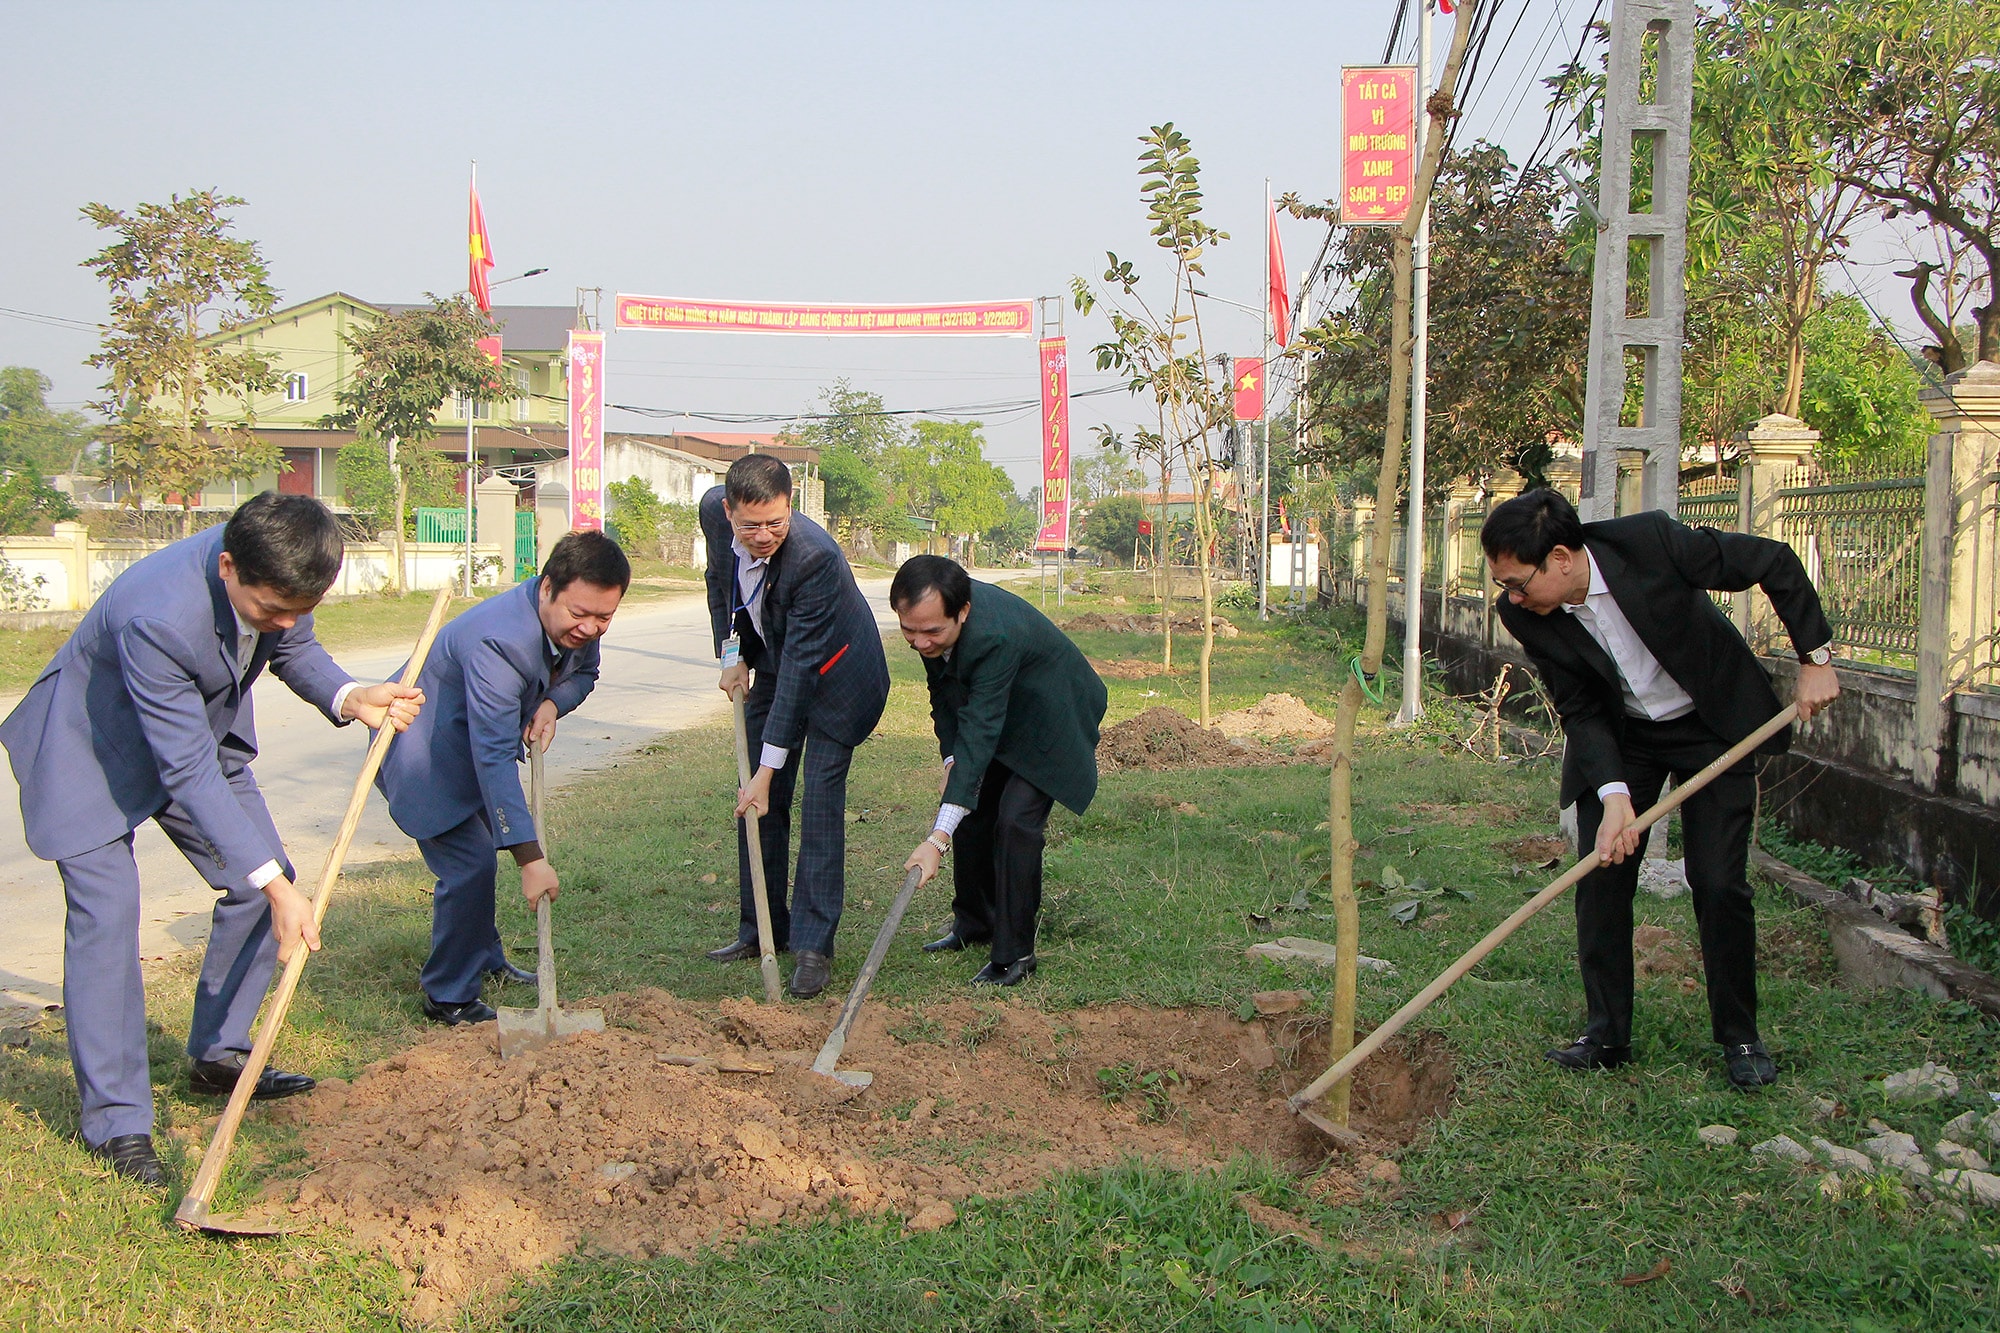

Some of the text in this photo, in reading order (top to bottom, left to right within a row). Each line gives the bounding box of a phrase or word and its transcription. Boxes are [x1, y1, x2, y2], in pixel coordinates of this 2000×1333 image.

[1359, 77, 1397, 100] TẤT CẢ
[1372, 106, 1384, 125] VÌ
[1350, 131, 1406, 151] MÔI TRƯỜNG
[1363, 160, 1393, 177] XANH
[1349, 186, 1377, 206] SẠCH
[1386, 185, 1406, 205] ĐẸP
[626, 304, 647, 323] NHIỆT
[648, 304, 663, 324] LIỆT
[664, 306, 684, 321] CHÀO
[708, 309, 718, 323] 90
[719, 308, 736, 323] NĂM
[738, 309, 758, 324] NGÀY
[759, 309, 782, 325] THÀNH
[784, 310, 798, 328] LẬP
[799, 308, 820, 326] ĐẢNG
[821, 311, 842, 330] CỘNG
[843, 309, 859, 326] SẢN
[860, 311, 876, 330] VIỆT
[877, 313, 895, 326] NAM
[896, 313, 921, 328] QUANG
[922, 313, 941, 326] VINH
